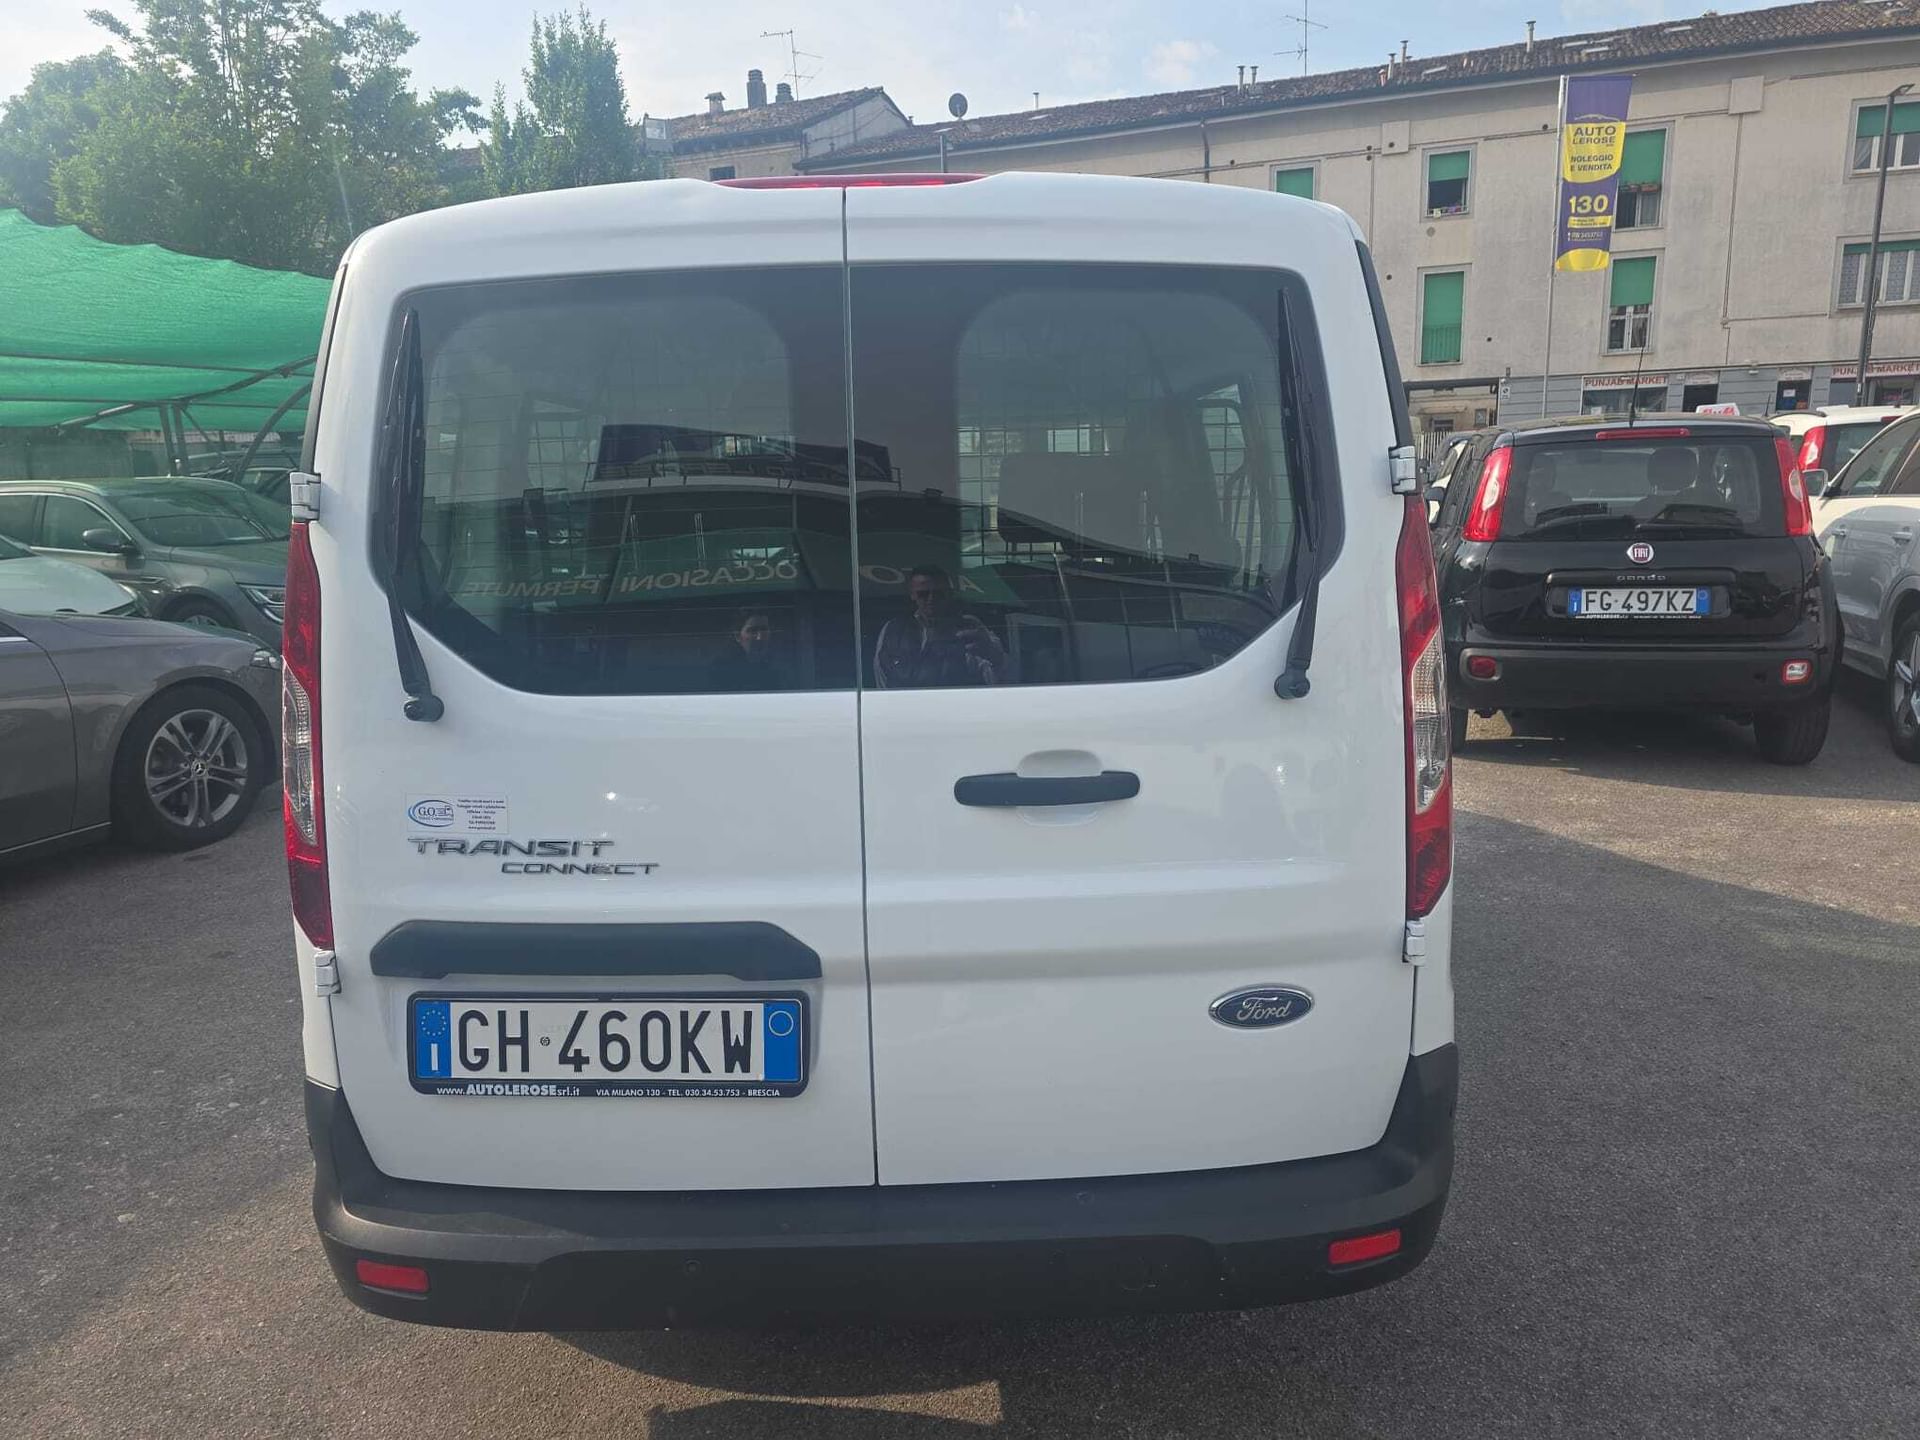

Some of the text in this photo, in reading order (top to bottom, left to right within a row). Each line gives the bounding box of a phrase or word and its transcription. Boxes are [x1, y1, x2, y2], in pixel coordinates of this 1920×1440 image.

[1573, 126, 1616, 136] AUTO
[1572, 136, 1615, 144] LEROSE
[1570, 154, 1614, 162] NOLEGGIO
[1577, 163, 1613, 171] VENDITA
[1569, 195, 1609, 213] 130
[407, 837, 614, 857] TRANSIT
[501, 862, 660, 875] CONNECT
[1236, 996, 1292, 1021] Ford
